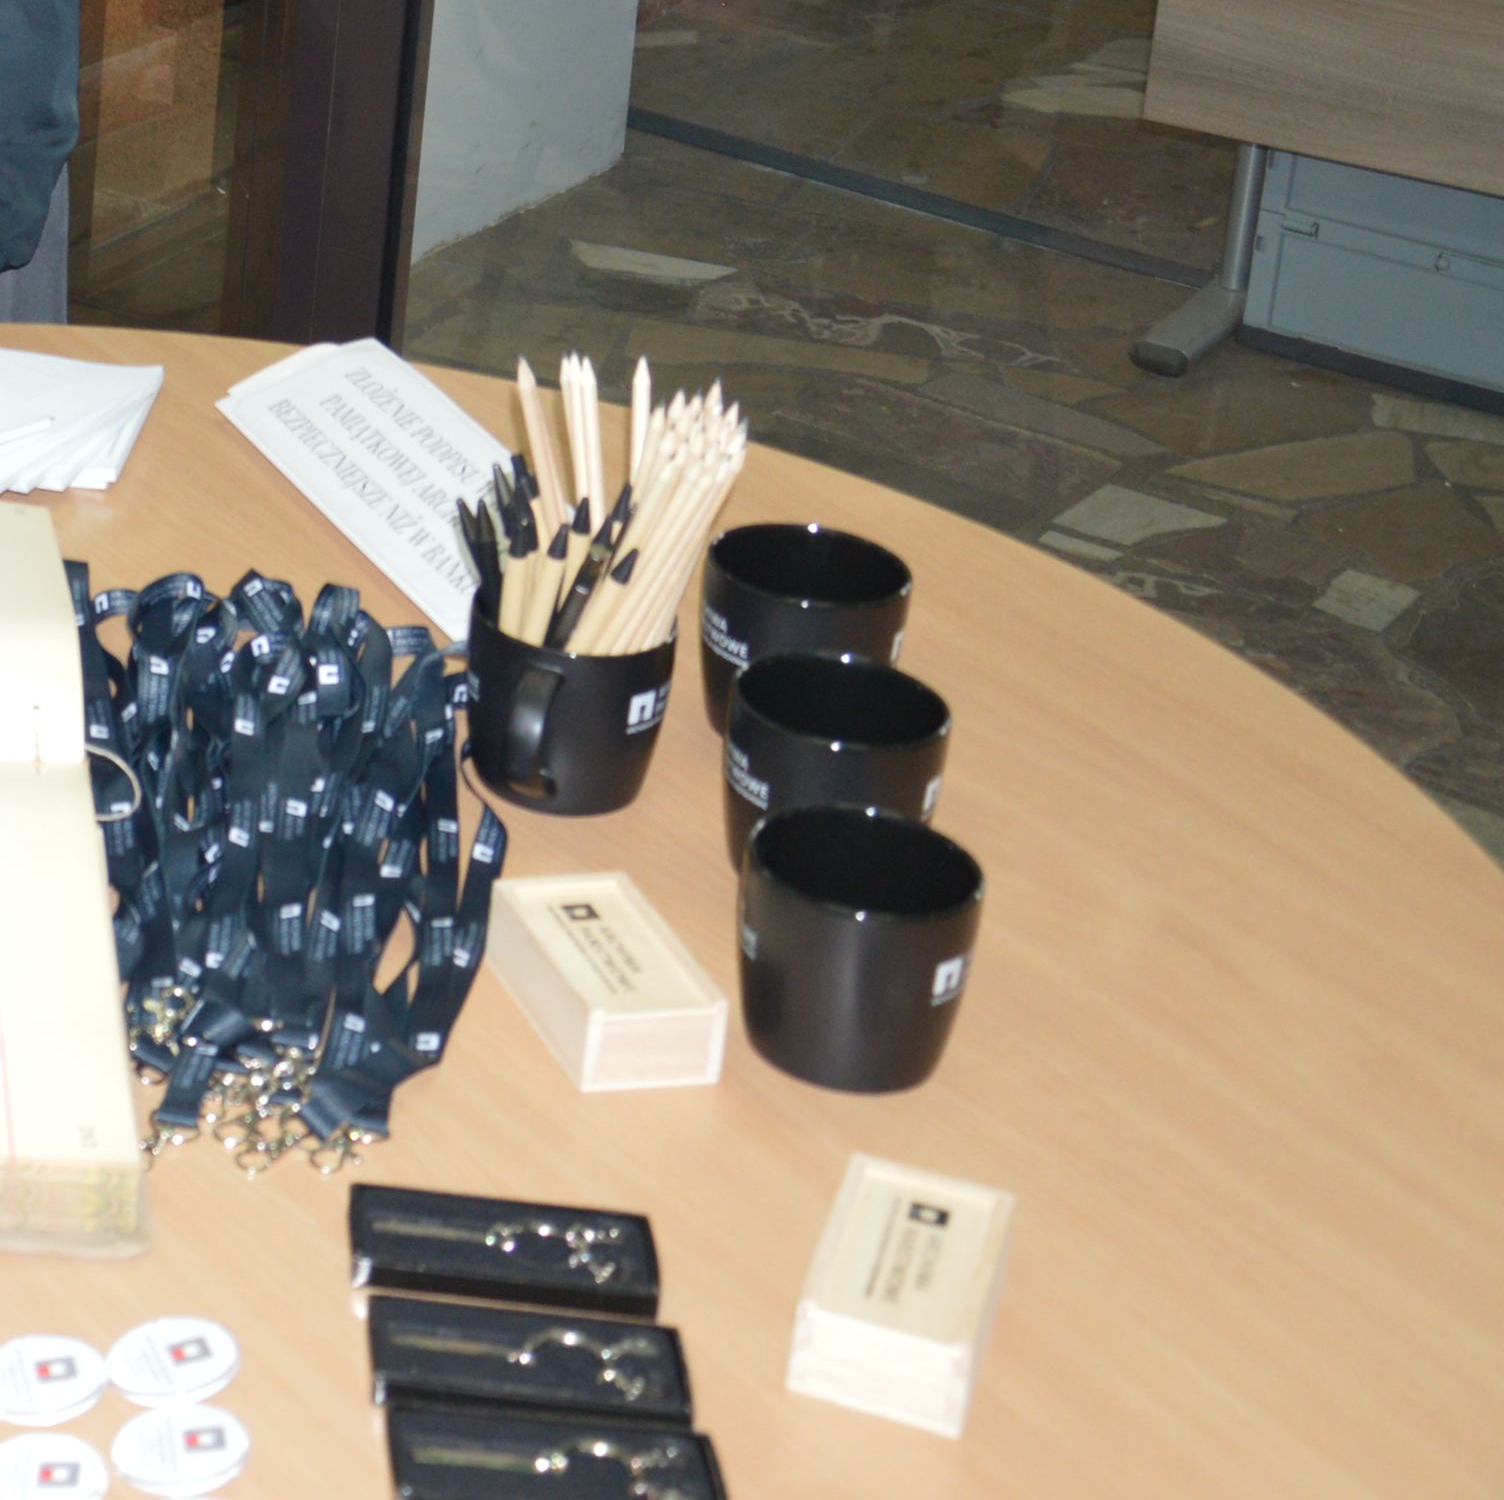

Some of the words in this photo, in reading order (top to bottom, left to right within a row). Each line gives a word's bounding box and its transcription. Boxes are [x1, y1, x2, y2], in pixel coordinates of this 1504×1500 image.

[268, 397, 395, 512] BEZPIECZNIEJSZE
[319, 392, 427, 487] PAMIĄTKOWEJ
[409, 426, 484, 485] PODPISU
